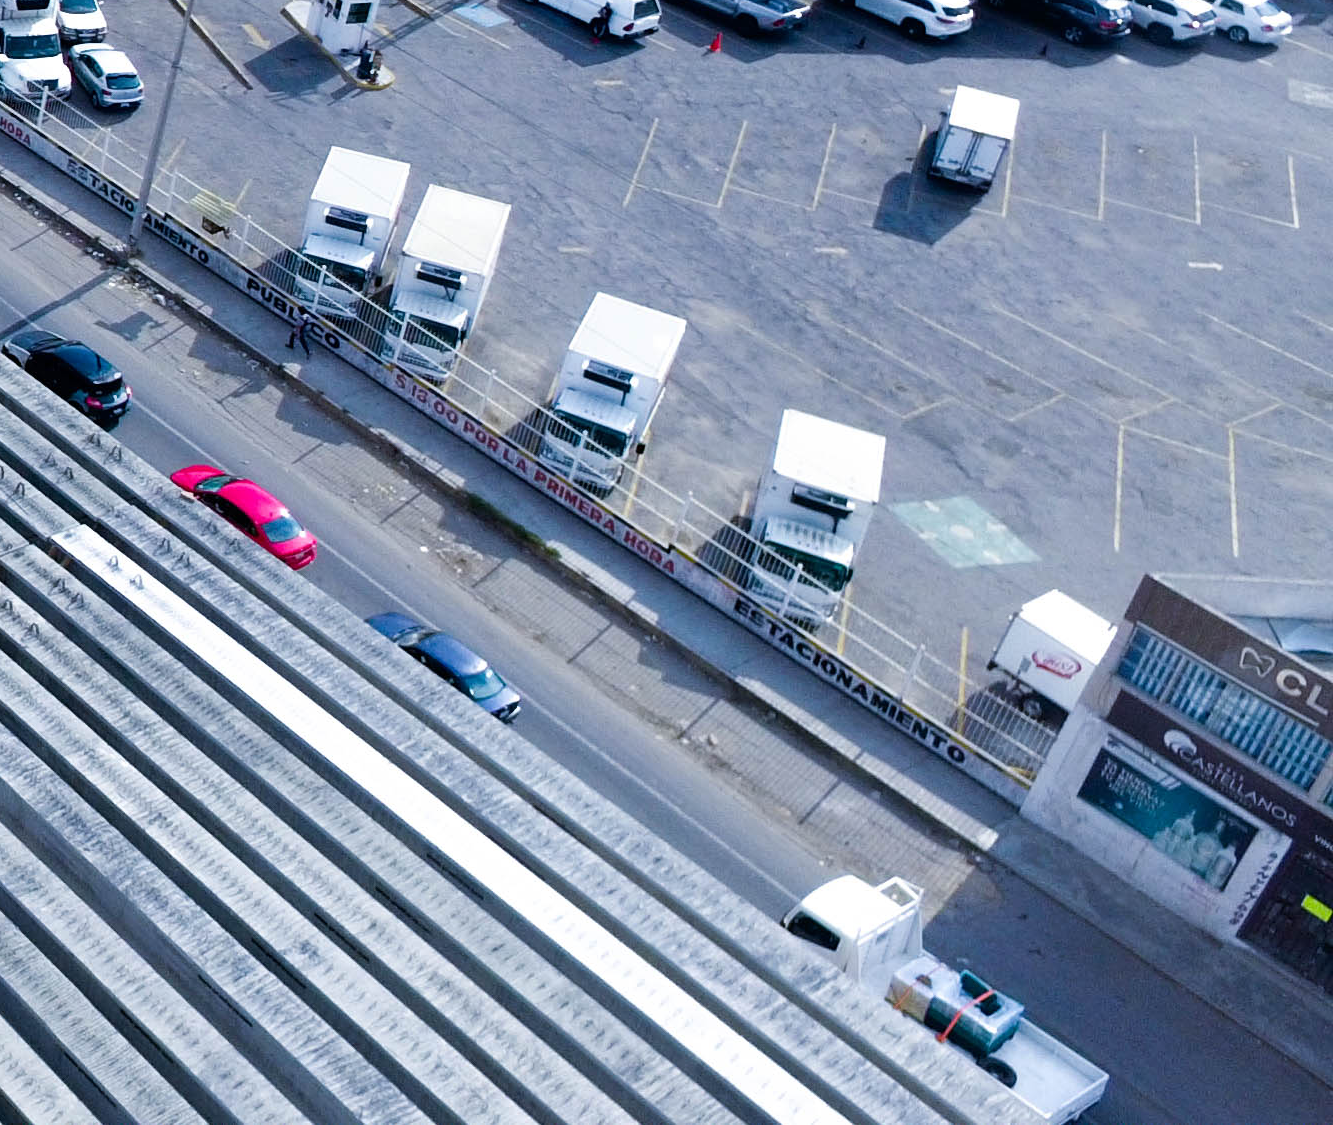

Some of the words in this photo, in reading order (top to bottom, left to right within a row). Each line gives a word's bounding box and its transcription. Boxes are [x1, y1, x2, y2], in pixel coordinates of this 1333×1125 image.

[0, 116, 31, 145] HORA
[247, 277, 351, 349] PUBLCO
[462, 420, 499, 451] POR
[503, 448, 528, 474] LA
[534, 471, 616, 535] PRIMERA
[623, 526, 677, 575] HORA
[733, 596, 967, 764] ESTACIONAMIENTO
